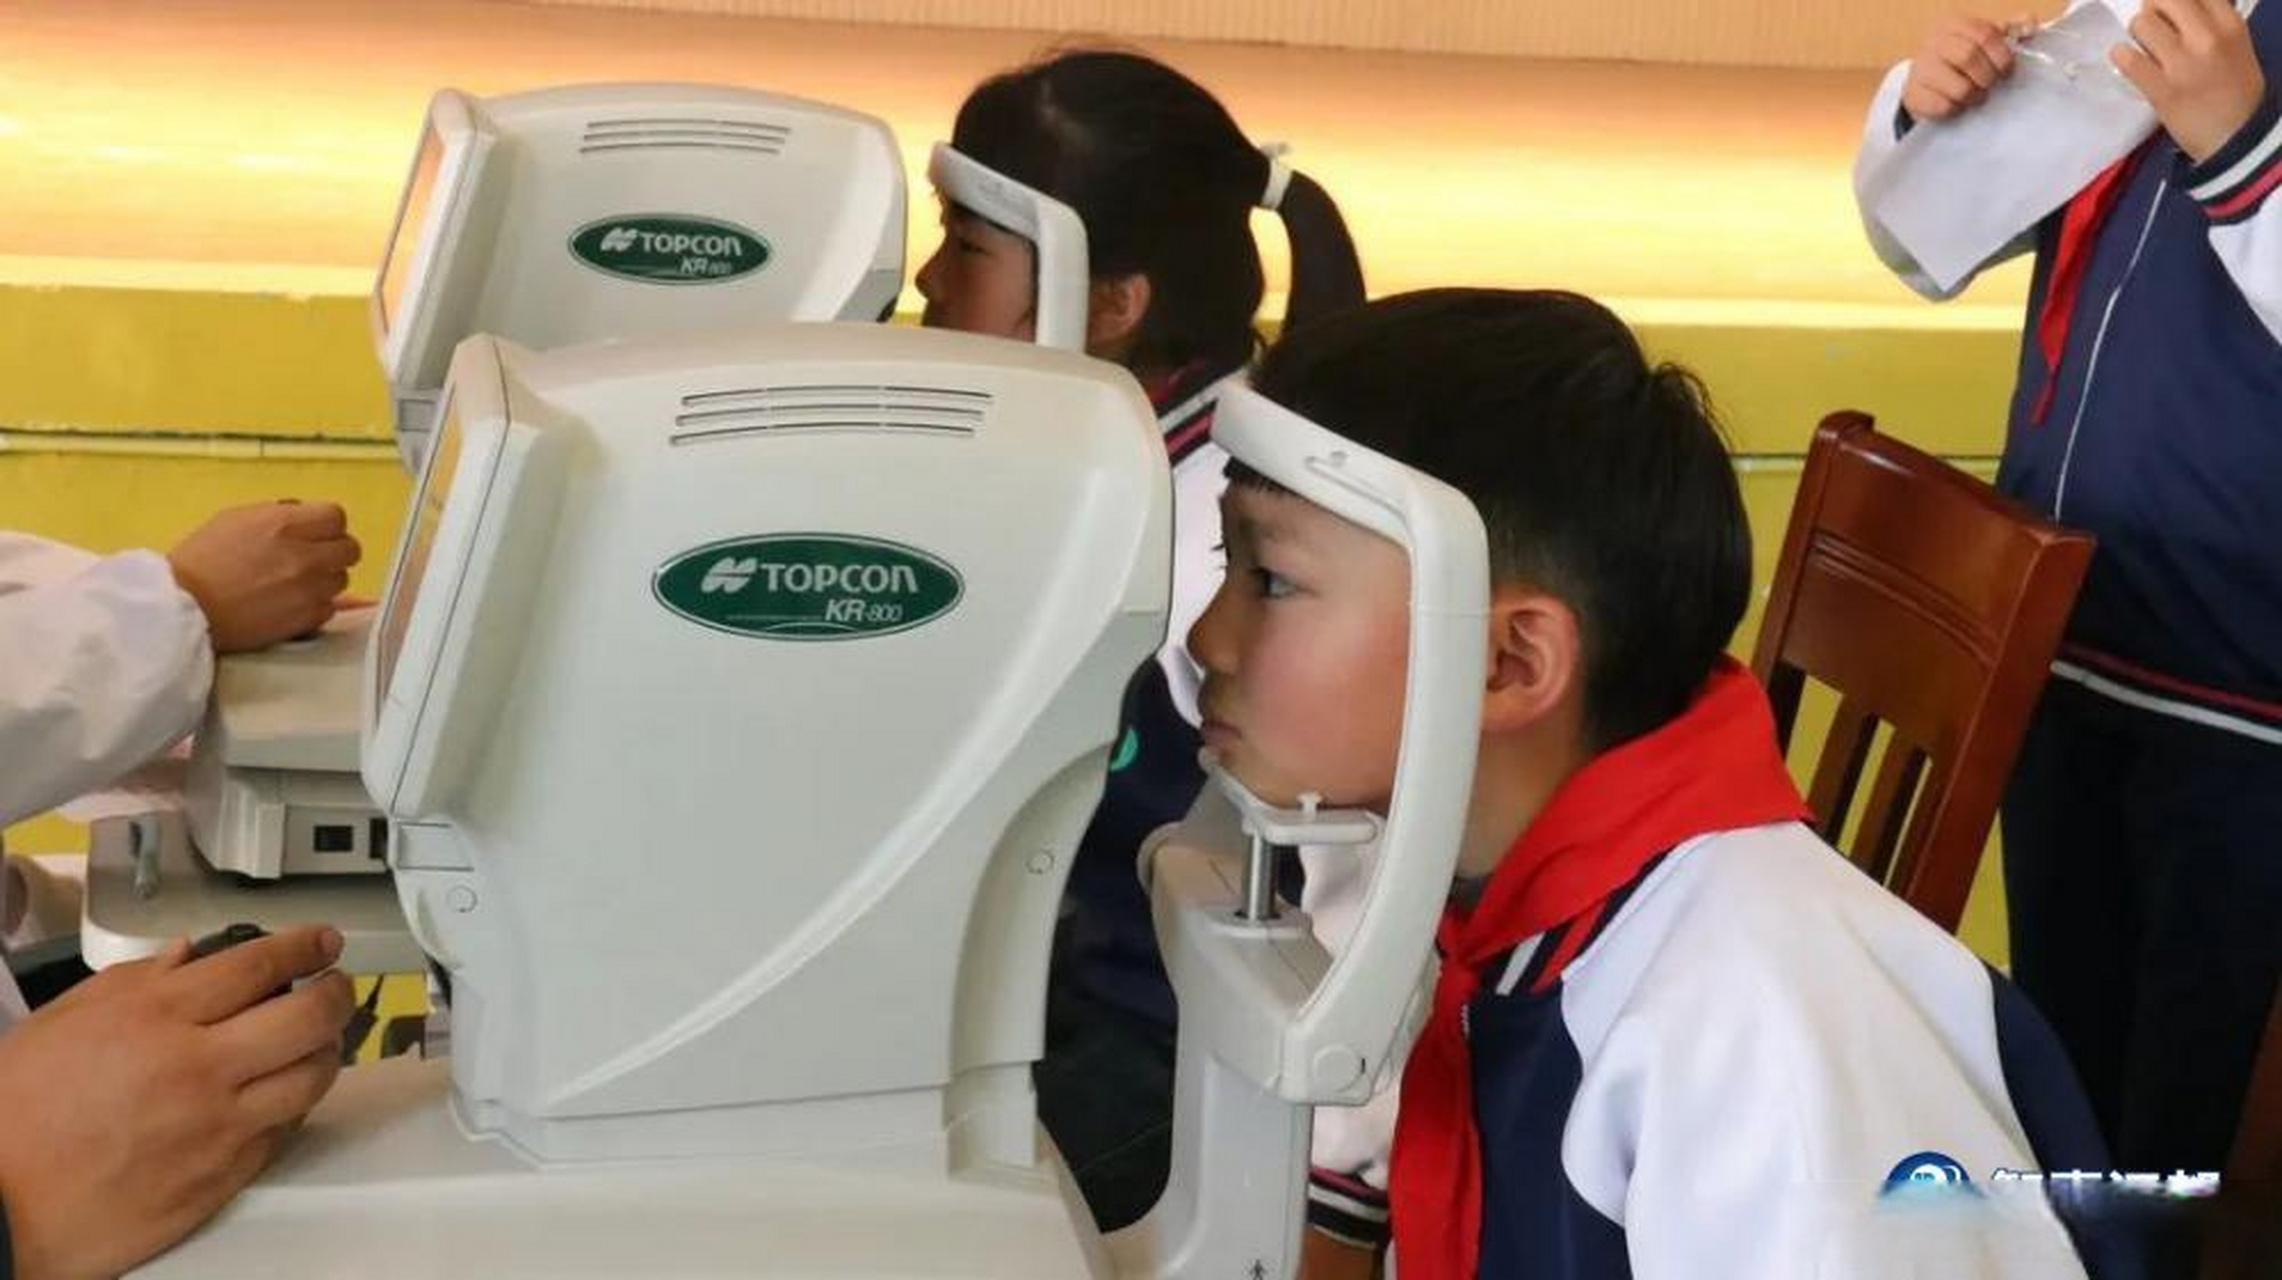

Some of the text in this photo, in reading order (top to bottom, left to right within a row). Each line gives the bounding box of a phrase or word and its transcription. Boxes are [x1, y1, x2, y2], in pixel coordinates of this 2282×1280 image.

[641, 233, 742, 256] TOPCON
[761, 563, 919, 593] TOPCON
[825, 599, 903, 622] KR-800
